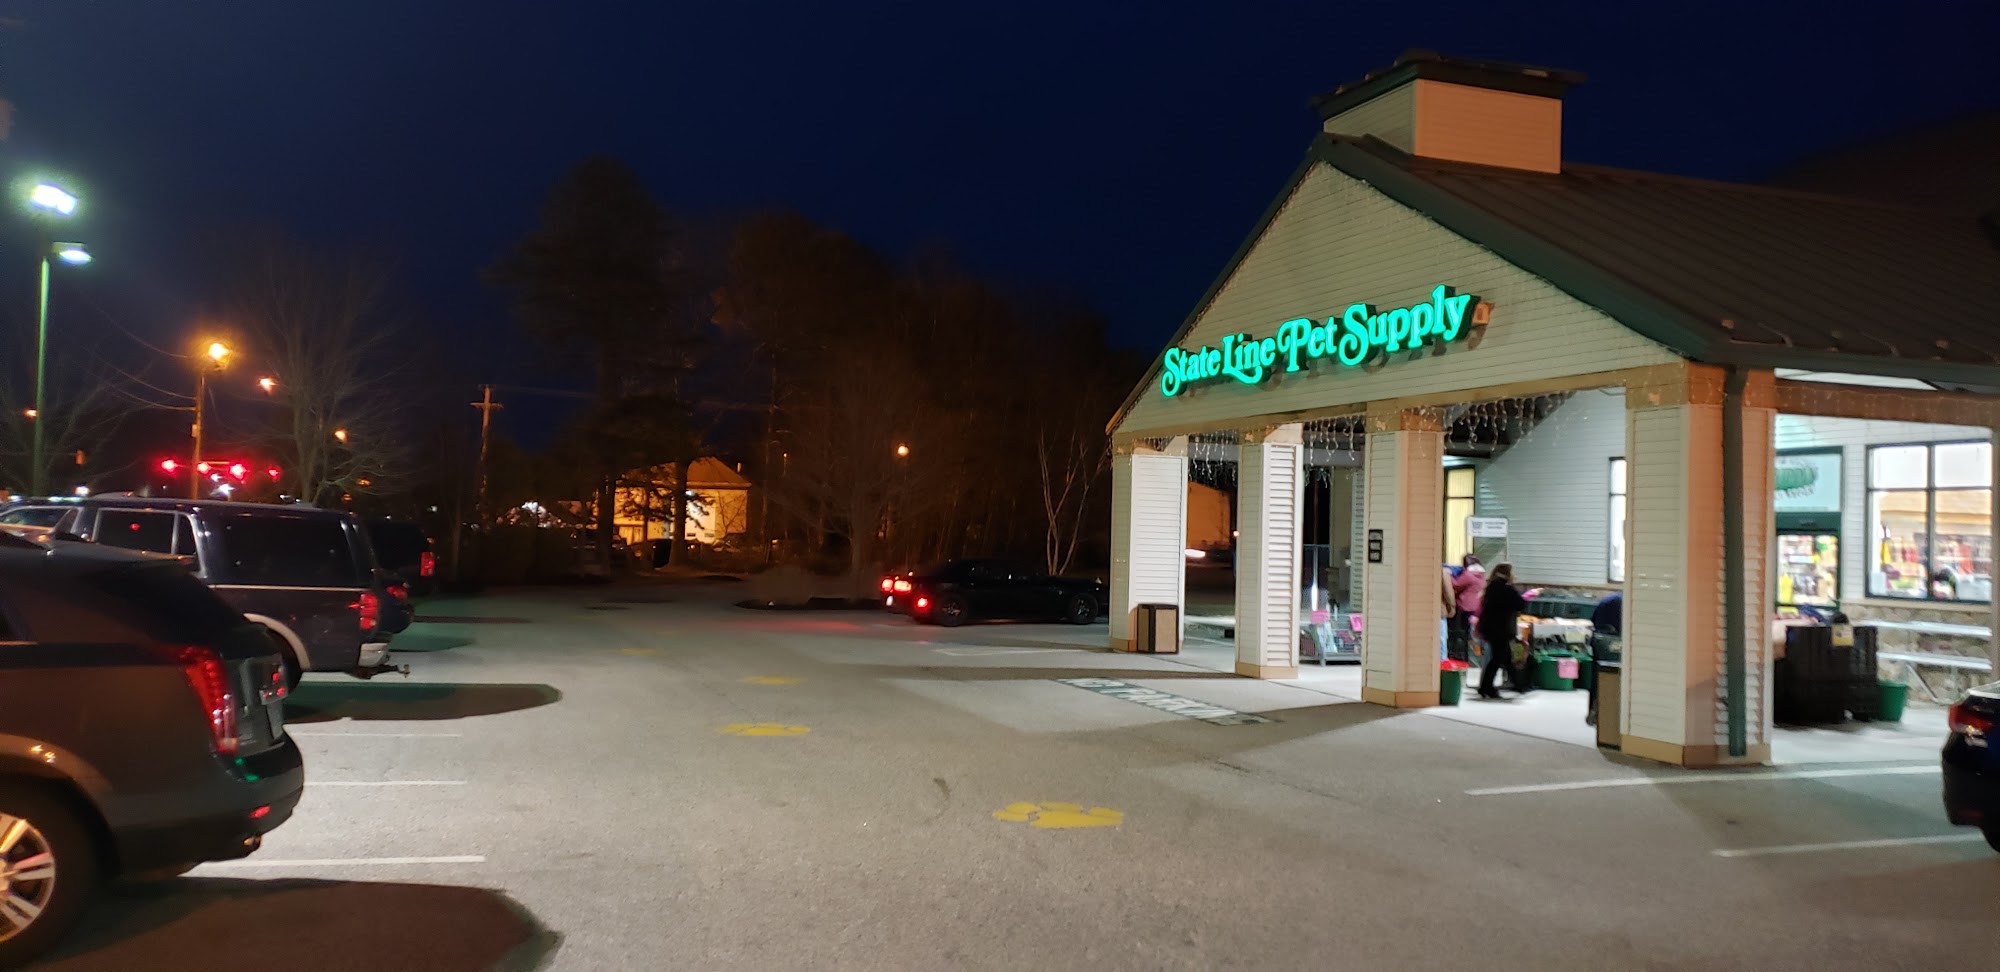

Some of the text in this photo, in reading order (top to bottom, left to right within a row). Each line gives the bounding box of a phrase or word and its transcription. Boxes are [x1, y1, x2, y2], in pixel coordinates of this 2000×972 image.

[1161, 284, 1471, 397] State Line Pet Supply
